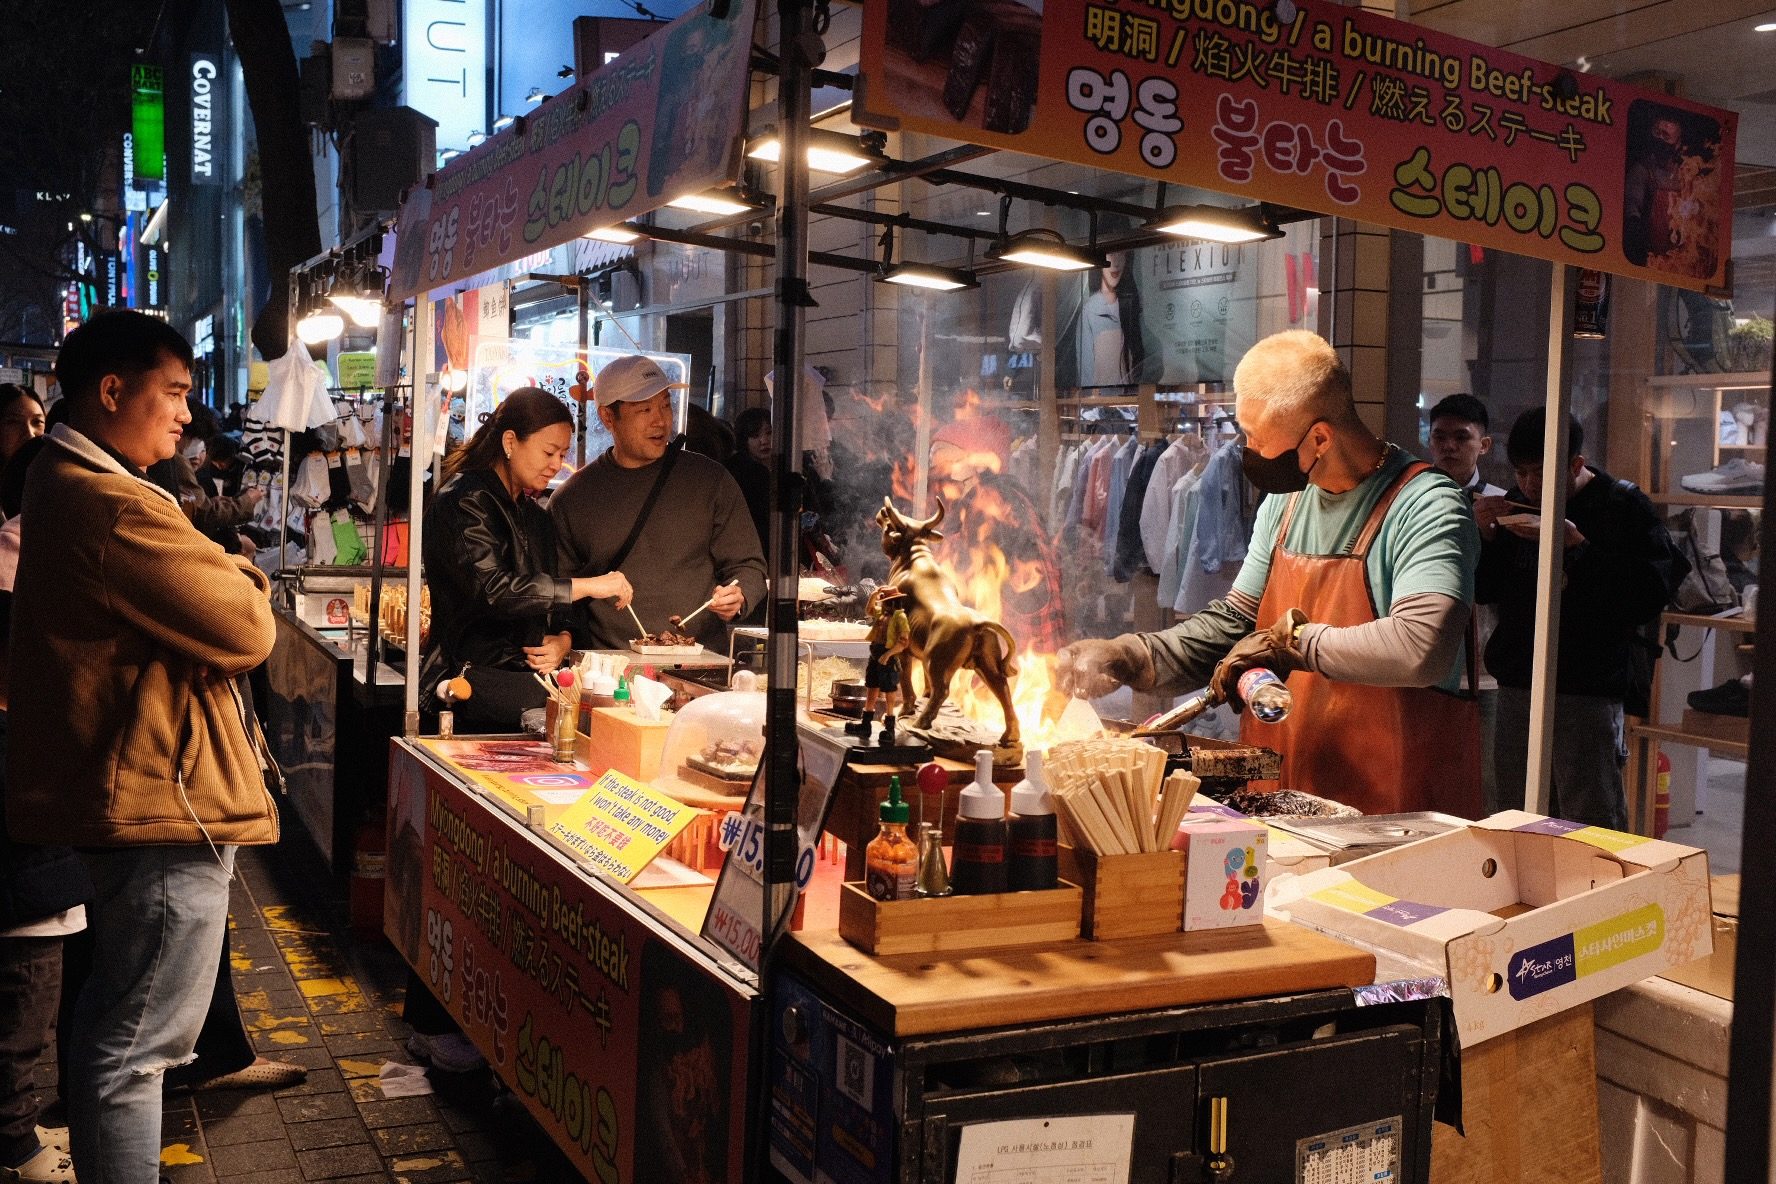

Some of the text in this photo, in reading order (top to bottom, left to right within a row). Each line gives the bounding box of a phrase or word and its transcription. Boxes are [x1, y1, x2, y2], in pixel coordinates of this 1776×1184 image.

[1087, 7, 1158, 60] 明洞
[1194, 31, 1339, 103] 焰火牛排
[1372, 72, 1586, 161] 燃えるステーキ
[1314, 24, 1332, 51] a
[1345, 21, 1460, 88] burning
[193, 60, 216, 176] COVERNAT
[1067, 67, 1605, 254] 명동 불타는 스테이크
[430, 206, 459, 280] 명동
[464, 176, 518, 270] 불타는
[523, 118, 641, 243] 스테이크
[599, 774, 612, 786] If
[604, 778, 619, 792] the
[616, 785, 637, 801] steak
[634, 792, 645, 805] is
[640, 797, 657, 812] not
[590, 792, 669, 845] I won't take any money
[431, 789, 484, 874] Myongdong
[493, 846, 501, 882] a
[503, 841, 548, 929] burning
[552, 885, 630, 992] Beef-steak
[1556, 954, 1572, 970] 영천
[428, 907, 619, 1184] 명동 불타는 스테이크
